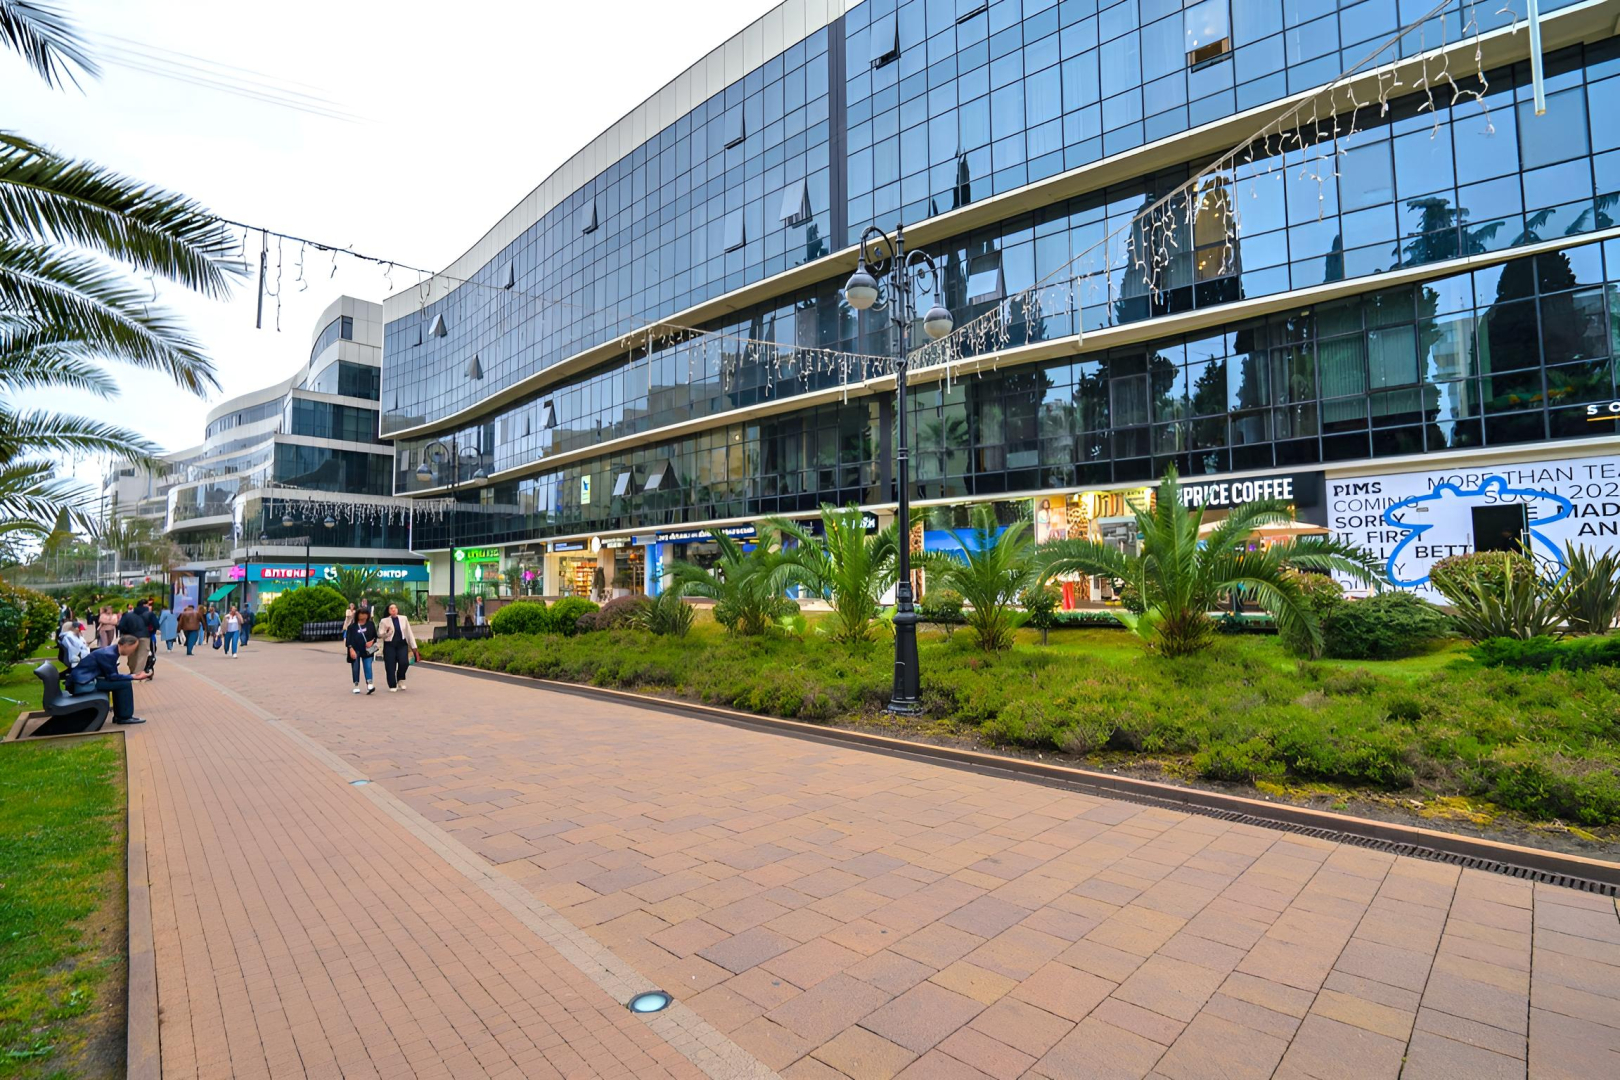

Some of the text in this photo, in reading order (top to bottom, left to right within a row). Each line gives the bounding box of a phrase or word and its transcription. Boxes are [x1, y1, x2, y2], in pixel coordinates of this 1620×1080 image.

[1183, 484, 1230, 507] PRICE
[1231, 478, 1294, 504] COFFEE
[1333, 463, 1620, 497] PIMS MORE THAN TE
[1333, 495, 1419, 513] COMING
[1484, 486, 1557, 504] SOON
[1335, 513, 1405, 529] SORRY
